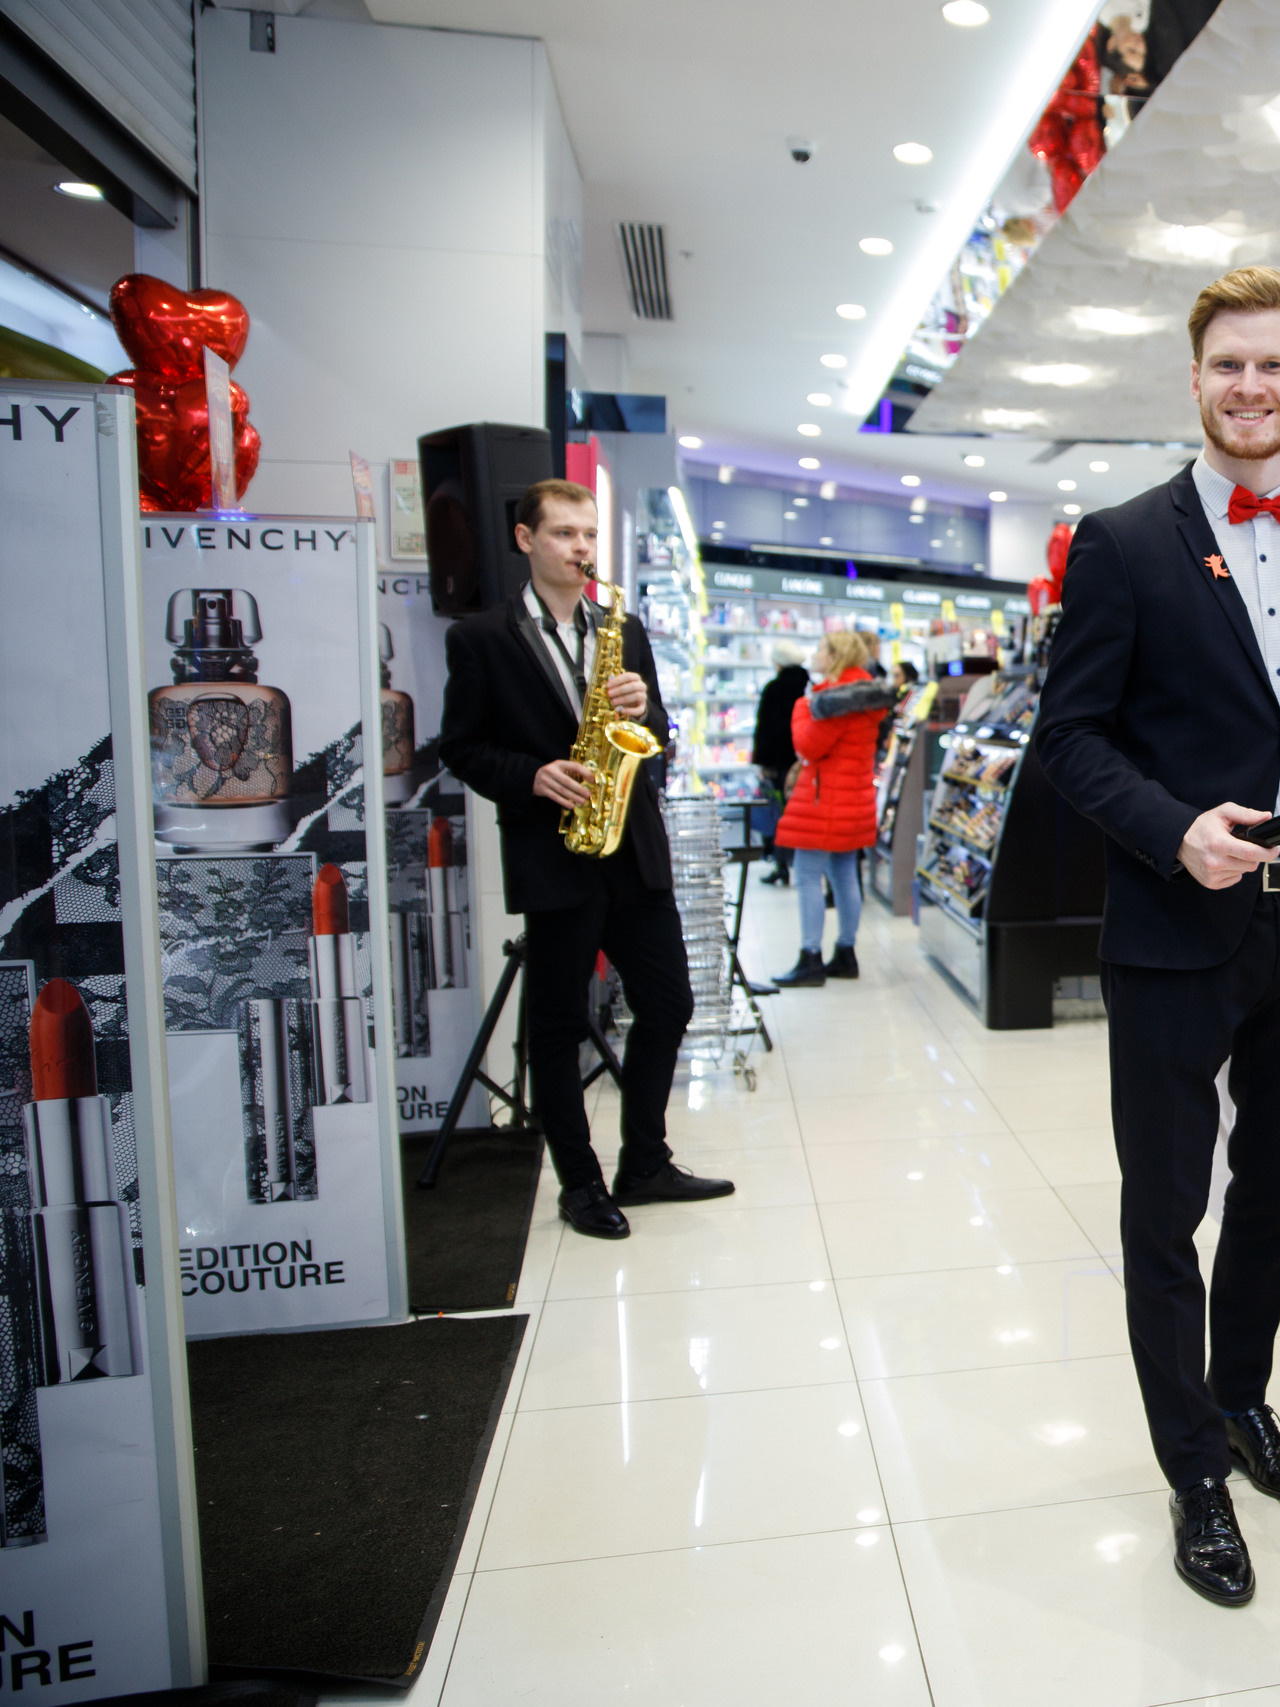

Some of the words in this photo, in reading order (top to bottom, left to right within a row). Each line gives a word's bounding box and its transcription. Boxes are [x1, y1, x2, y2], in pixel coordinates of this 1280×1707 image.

[179, 1239, 313, 1271] EDITION
[71, 1231, 94, 1333] GIVENCHY
[181, 1260, 346, 1297] COUTURE
